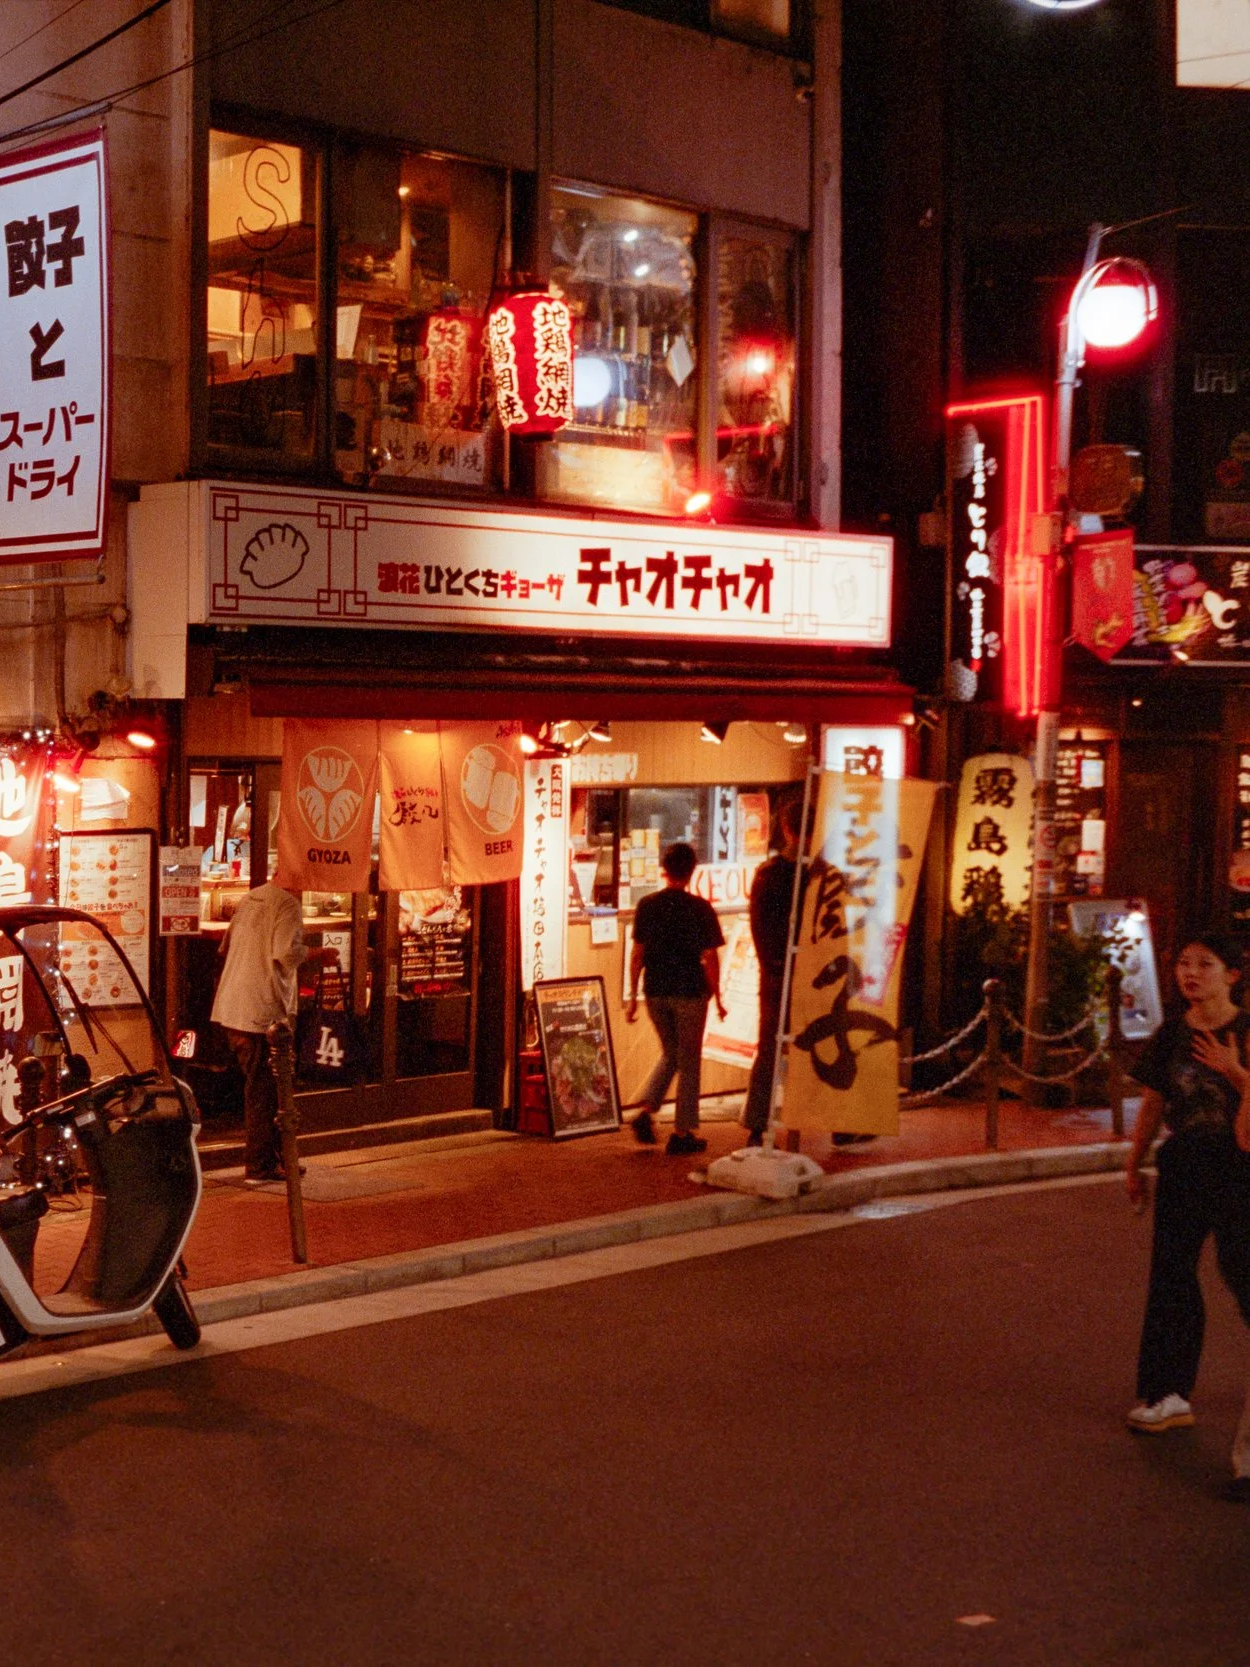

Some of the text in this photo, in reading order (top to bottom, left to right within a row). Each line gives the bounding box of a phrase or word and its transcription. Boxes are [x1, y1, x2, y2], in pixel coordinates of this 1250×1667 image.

[4, 204, 85, 298] 餃子
[28, 318, 66, 381] と
[7, 455, 81, 502] ドライ
[577, 547, 774, 614] チャオチャオ
[307, 848, 351, 865] GYOZA
[484, 840, 513, 856] BEER
[316, 1026, 345, 1067] LA
